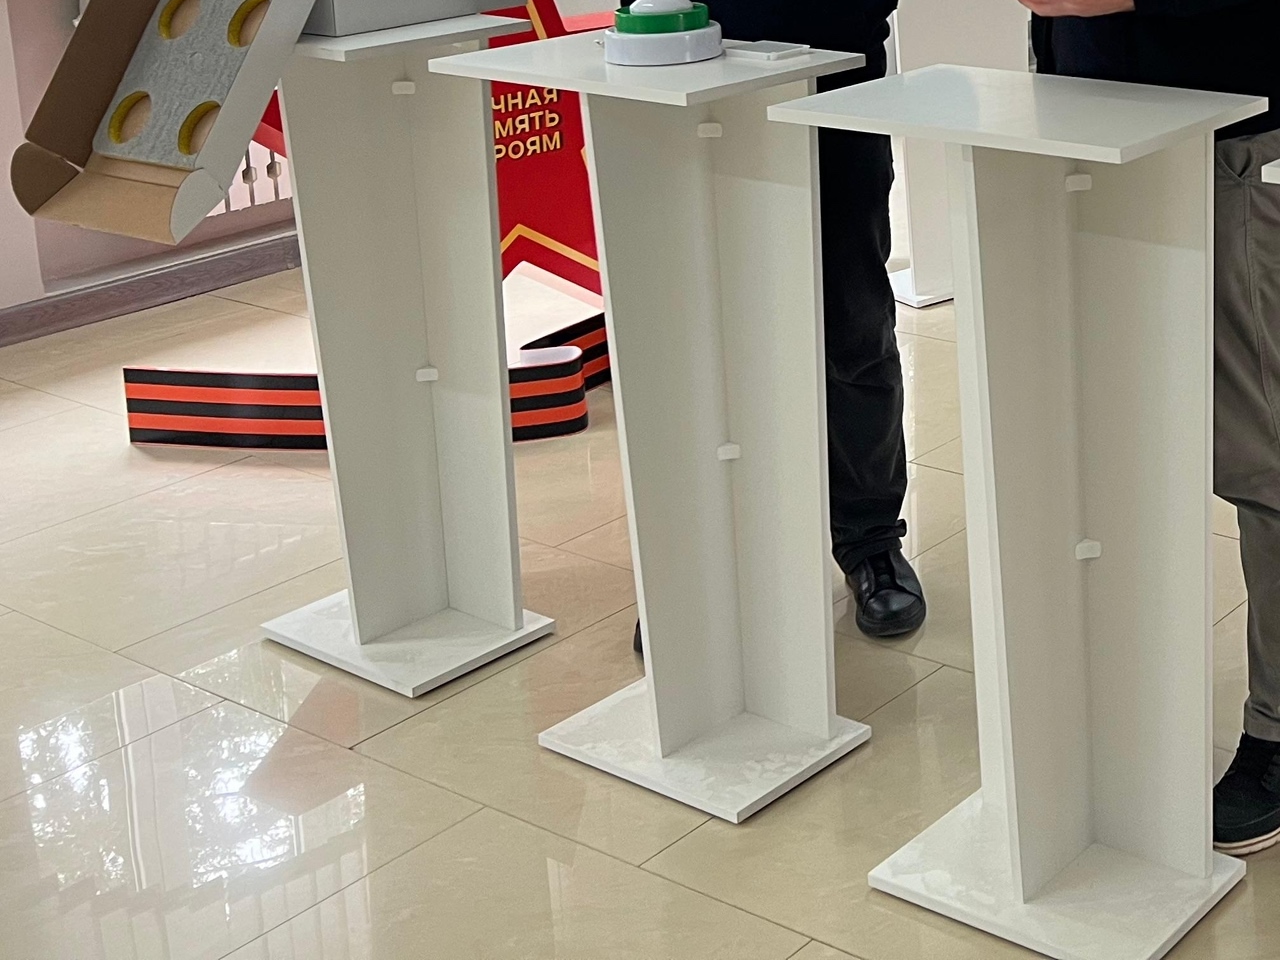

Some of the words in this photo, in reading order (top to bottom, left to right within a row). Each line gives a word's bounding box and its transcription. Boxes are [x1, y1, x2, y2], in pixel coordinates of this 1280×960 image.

[492, 87, 558, 114] ЧНАЯ
[495, 110, 560, 139] МЯТЬ
[495, 131, 561, 161] РОЯМ
